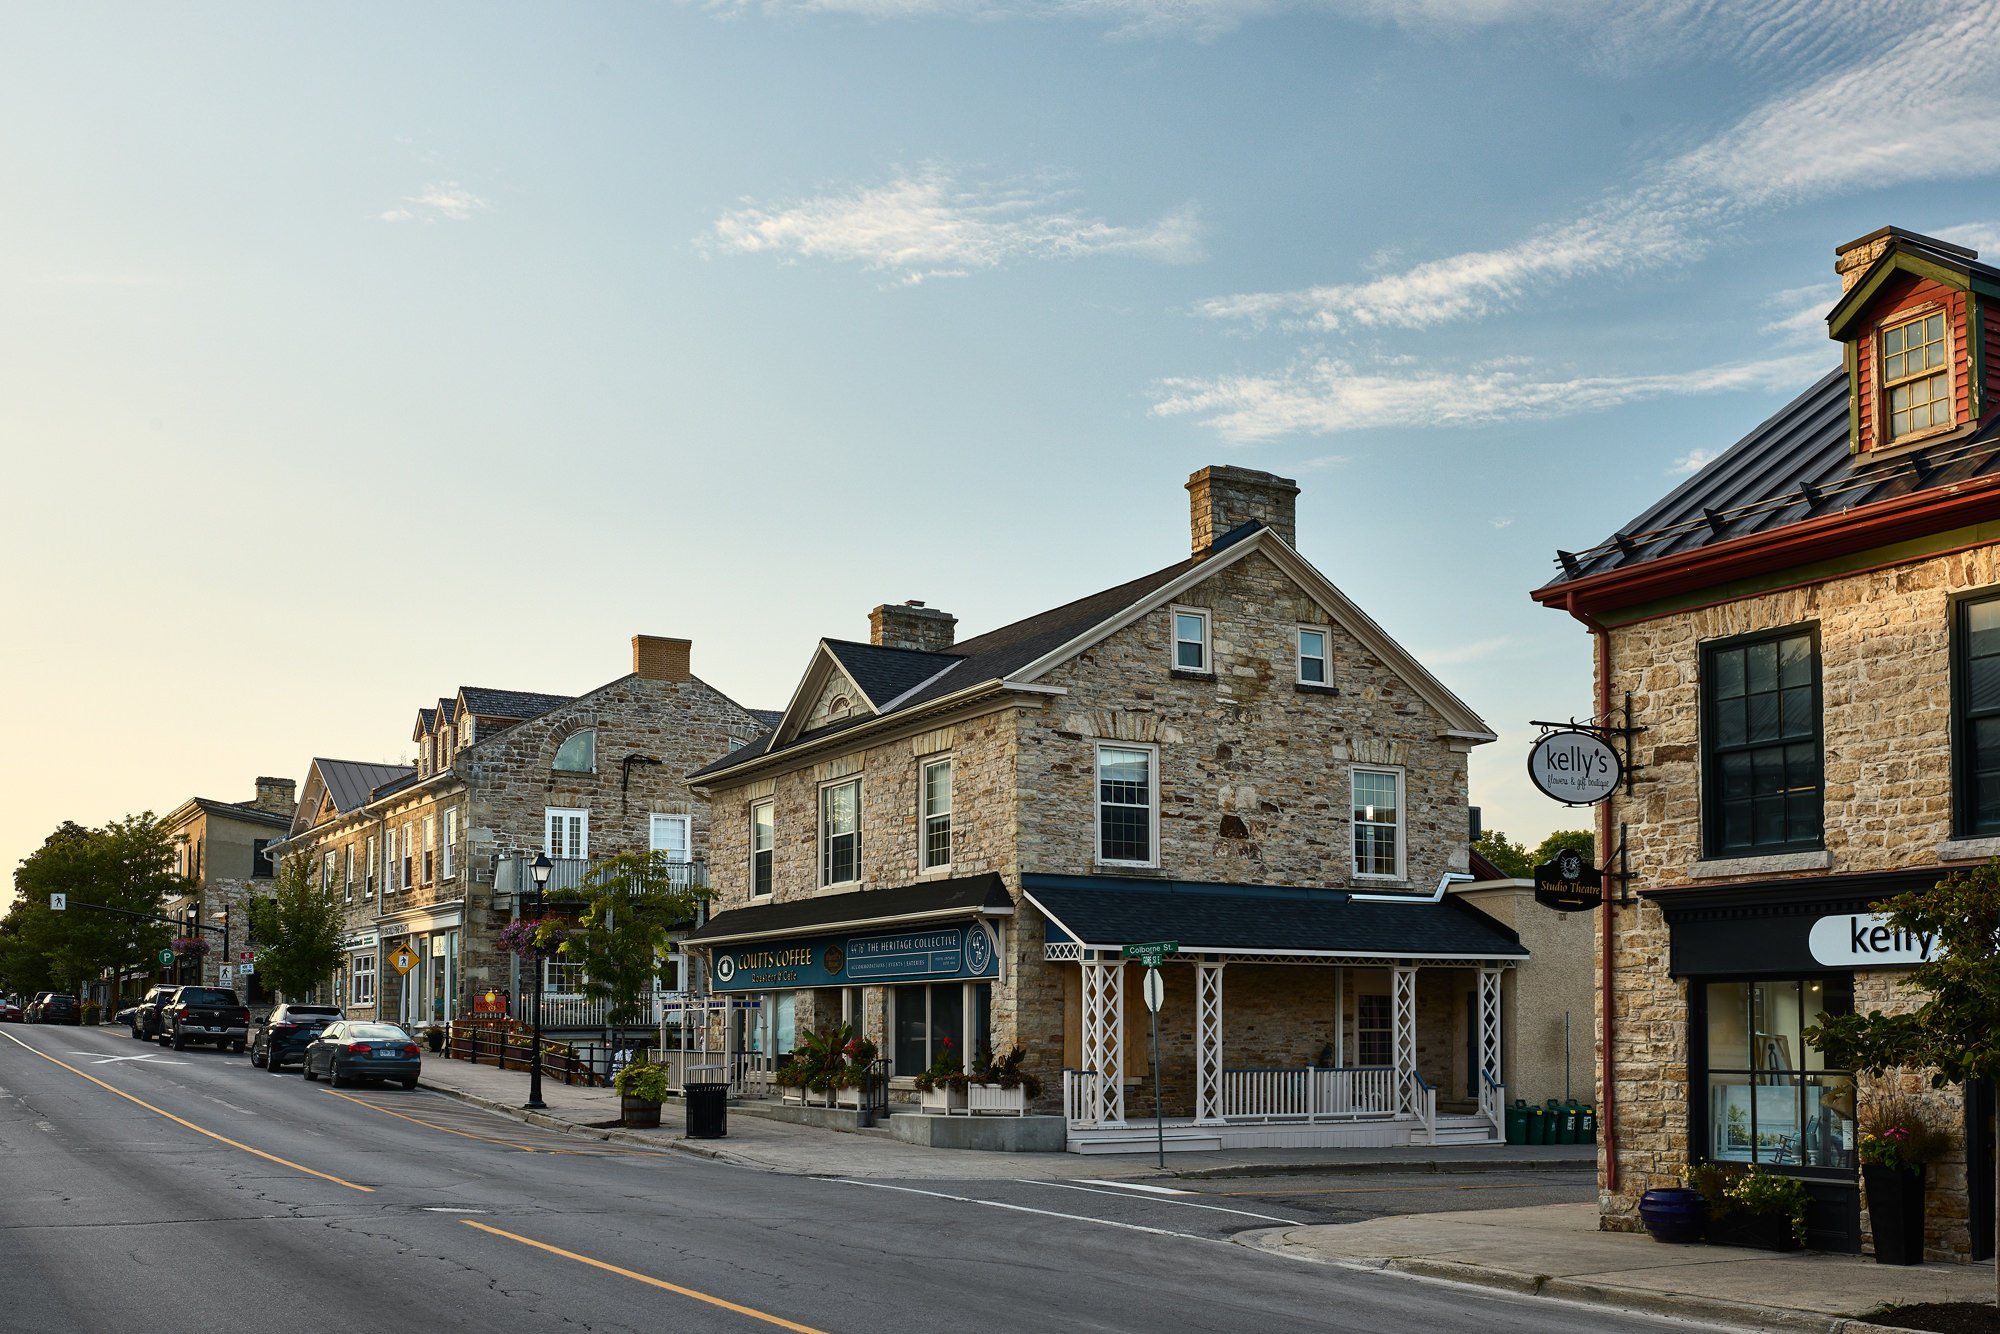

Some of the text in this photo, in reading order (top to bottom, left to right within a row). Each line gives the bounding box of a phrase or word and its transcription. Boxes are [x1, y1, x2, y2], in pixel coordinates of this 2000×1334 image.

[1547, 744, 1607, 778] kelly's
[1547, 774, 1609, 790] flowers & gift boutique
[1541, 880, 1601, 895] Studio Theatre
[868, 943, 880, 953] THE
[881, 939, 912, 951] HERITAGE
[914, 935, 956, 949] COLLECTIVE
[1129, 943, 1174, 954] Colborne St.
[163, 952, 171, 962] P
[738, 951, 773, 970] COUTTS
[775, 948, 812, 967] COFFEE
[906, 959, 925, 967] EATERIES
[752, 973, 777, 984] Roastery
